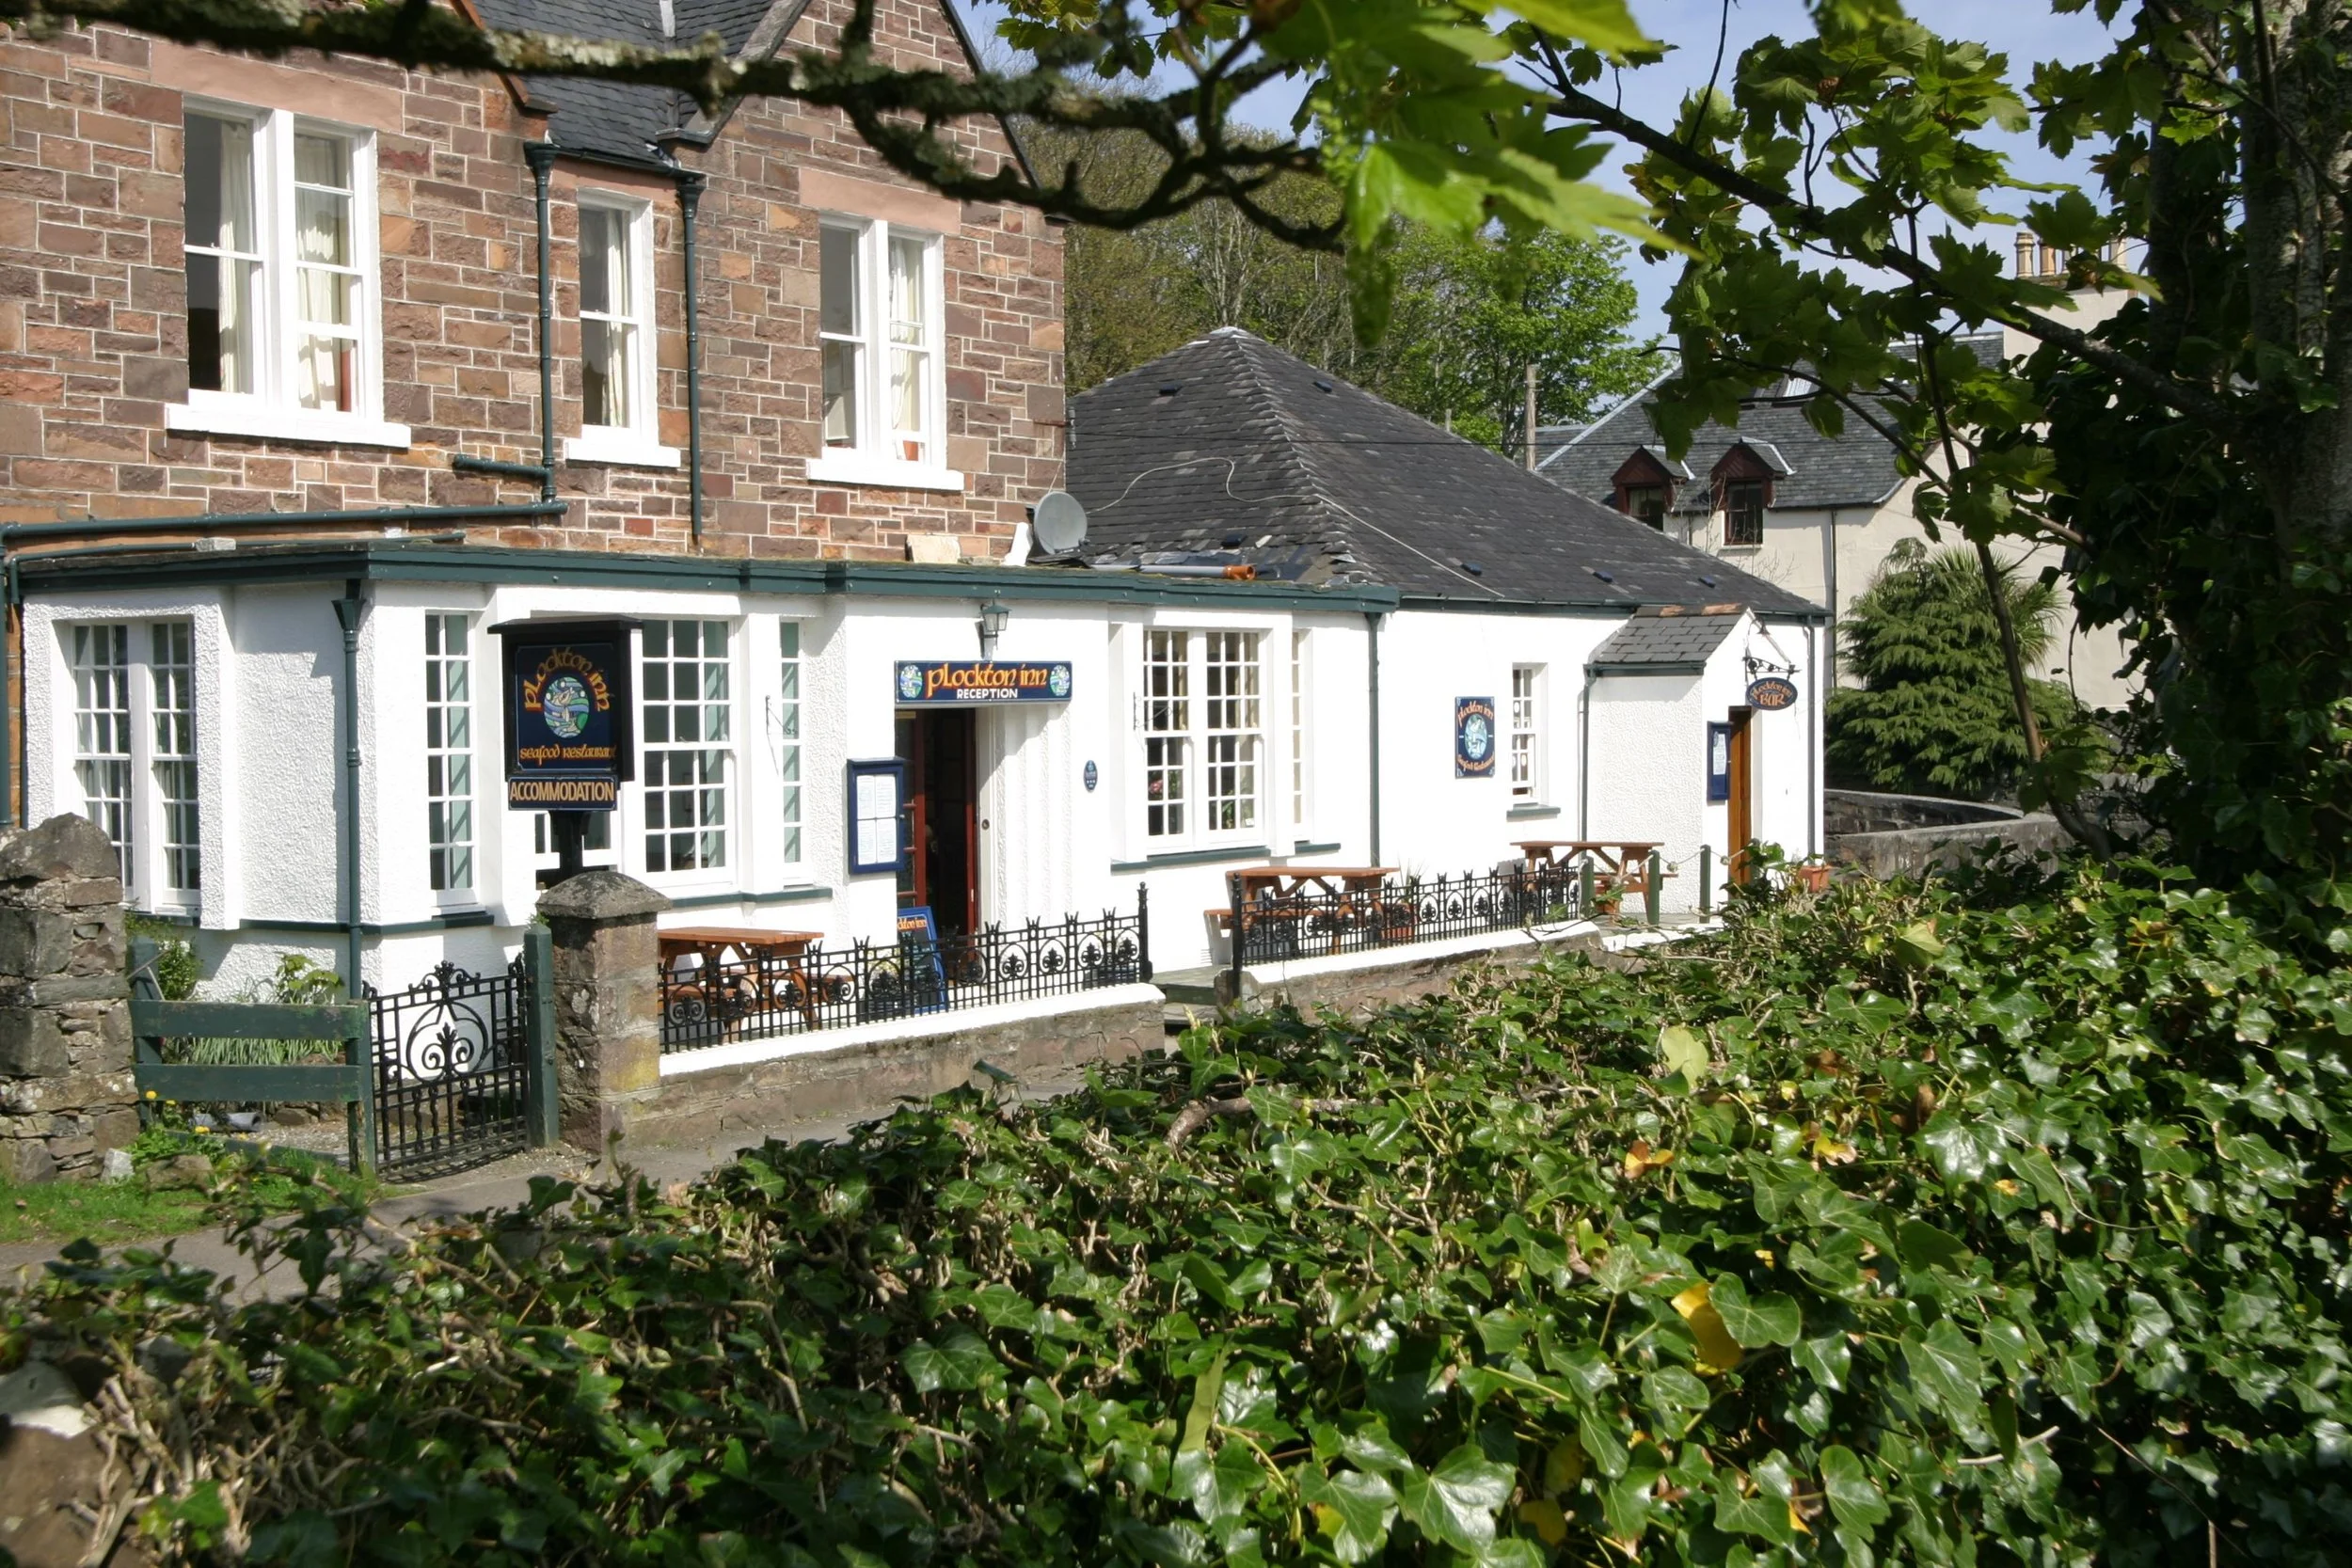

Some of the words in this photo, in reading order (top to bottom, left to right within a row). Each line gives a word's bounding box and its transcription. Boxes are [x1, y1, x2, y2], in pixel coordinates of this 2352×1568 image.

[1020, 663, 1048, 688] inn
[956, 688, 1018, 700] RECEPTION
[1760, 693, 1786, 706] BAR
[509, 781, 614, 801] ACCOMMODATION
